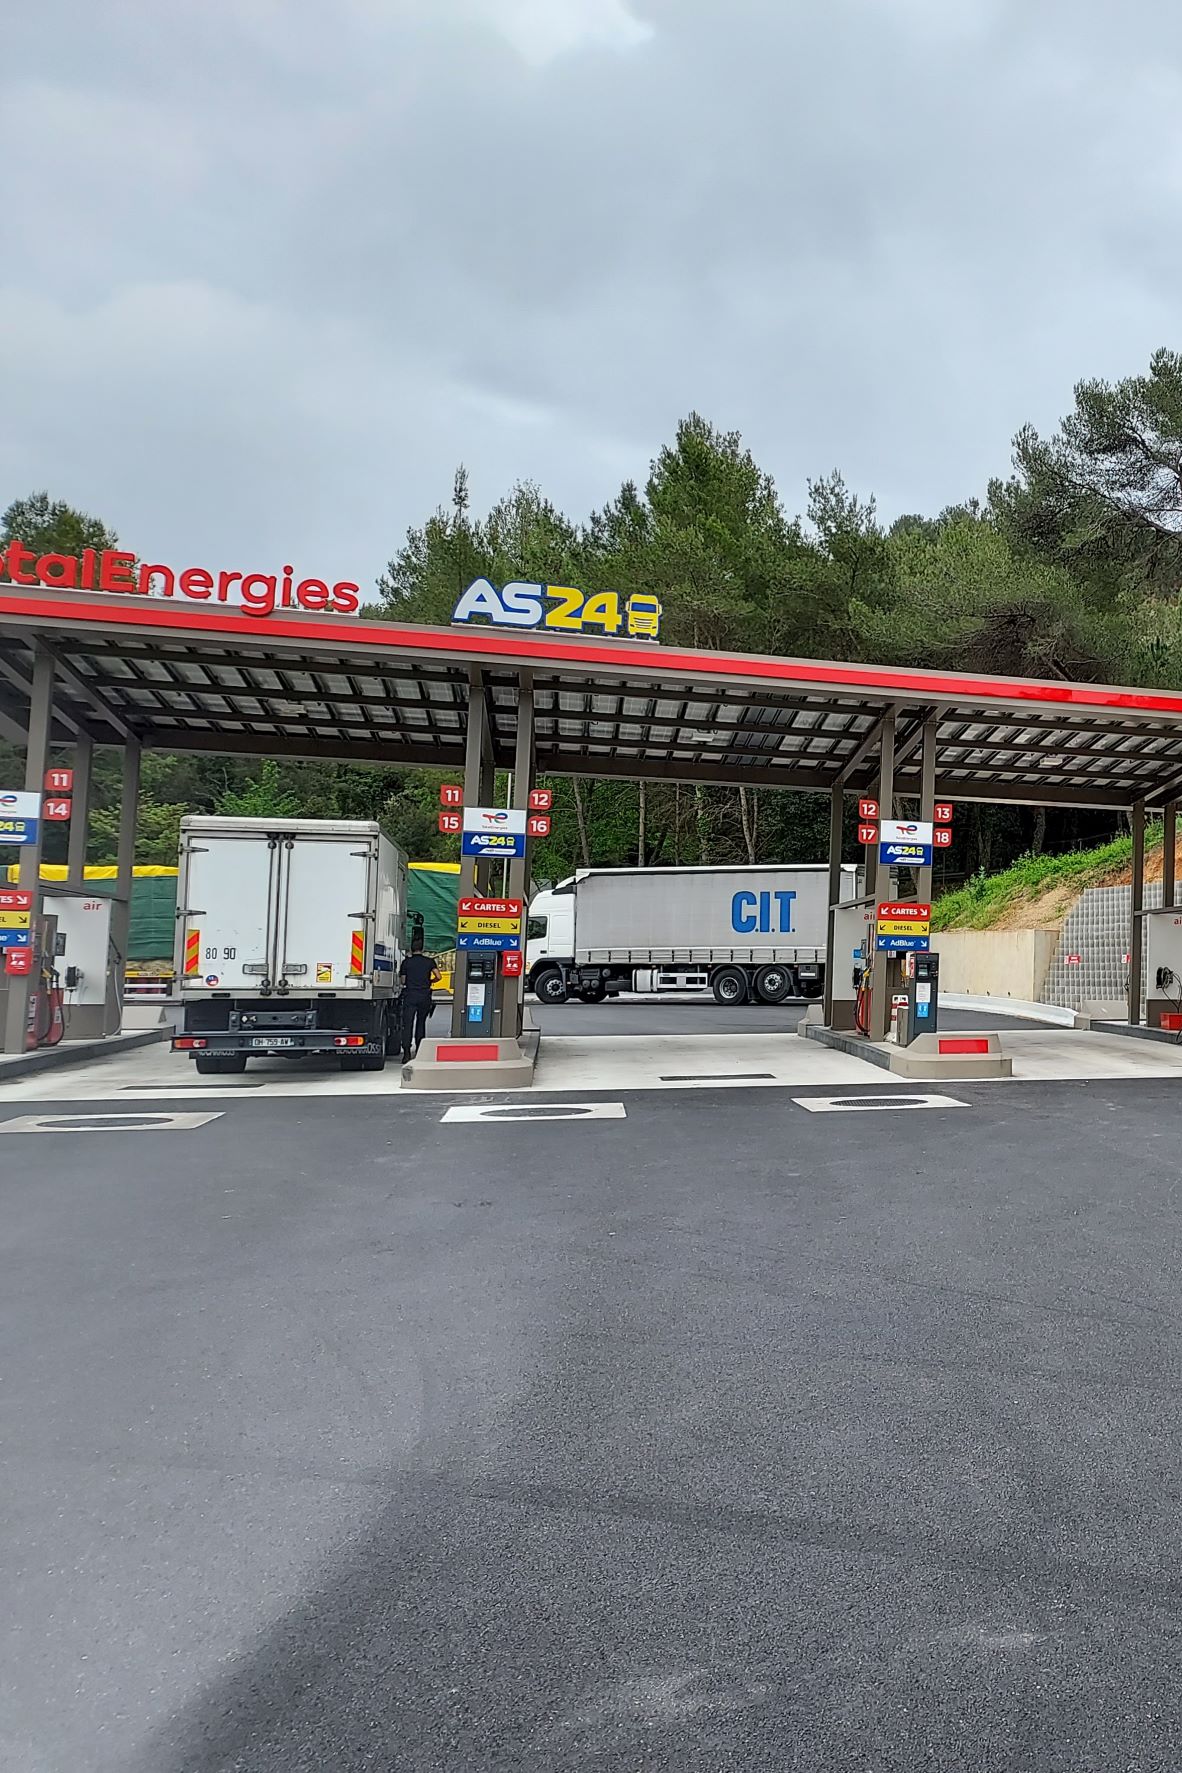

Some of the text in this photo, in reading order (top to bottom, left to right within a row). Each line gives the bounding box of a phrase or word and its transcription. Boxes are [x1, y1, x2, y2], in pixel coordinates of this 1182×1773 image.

[0, 540, 359, 617] talEnergies
[452, 576, 624, 635] AS24
[51, 773, 68, 787] 11
[445, 790, 459, 802] 11
[532, 793, 548, 806] 12
[46, 802, 68, 816] 14
[862, 804, 876, 815] 12
[936, 808, 950, 819] 13
[442, 816, 459, 829] 15
[530, 820, 547, 833] 16
[470, 835, 506, 846] AS24
[861, 829, 876, 840] 17
[935, 831, 949, 843] 18
[886, 845, 916, 856] AS24
[83, 901, 102, 910] air
[474, 903, 506, 912] CARTES
[891, 907, 918, 915] CARTES
[473, 937, 502, 946] AdBlue
[206, 947, 236, 960] 80 90
